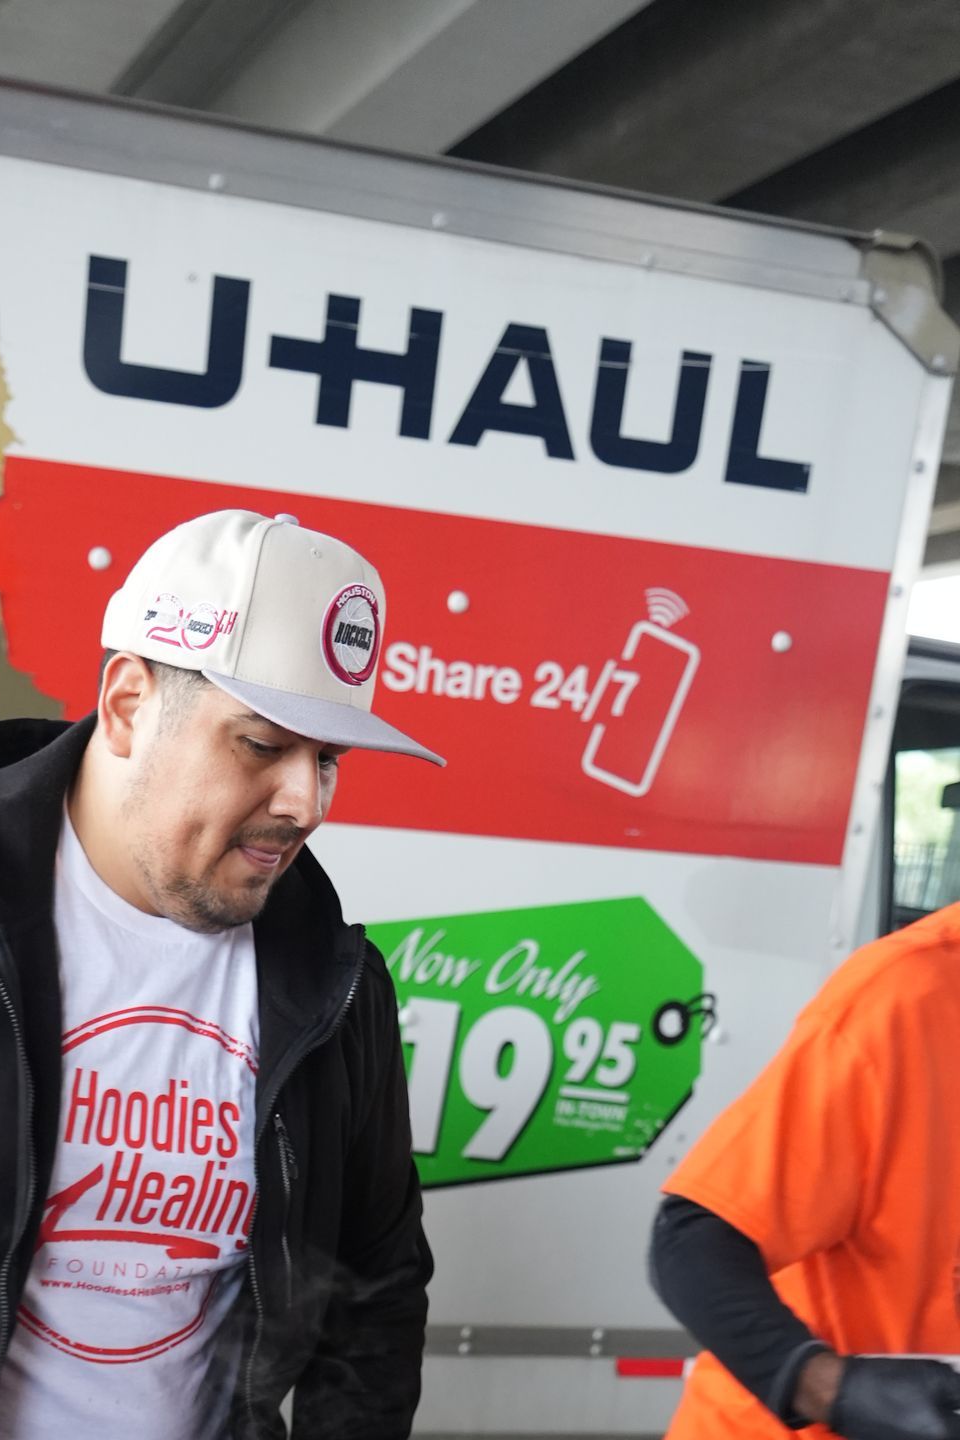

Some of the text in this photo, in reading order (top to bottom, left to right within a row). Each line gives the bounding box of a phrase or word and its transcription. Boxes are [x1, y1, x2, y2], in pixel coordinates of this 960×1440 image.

[336, 586, 376, 608] HOUSTON
[382, 641, 640, 722] Share 24/7
[387, 927, 600, 1025] Now Only
[63, 1067, 240, 1159] Hoodies
[401, 996, 641, 1162] 19 95
